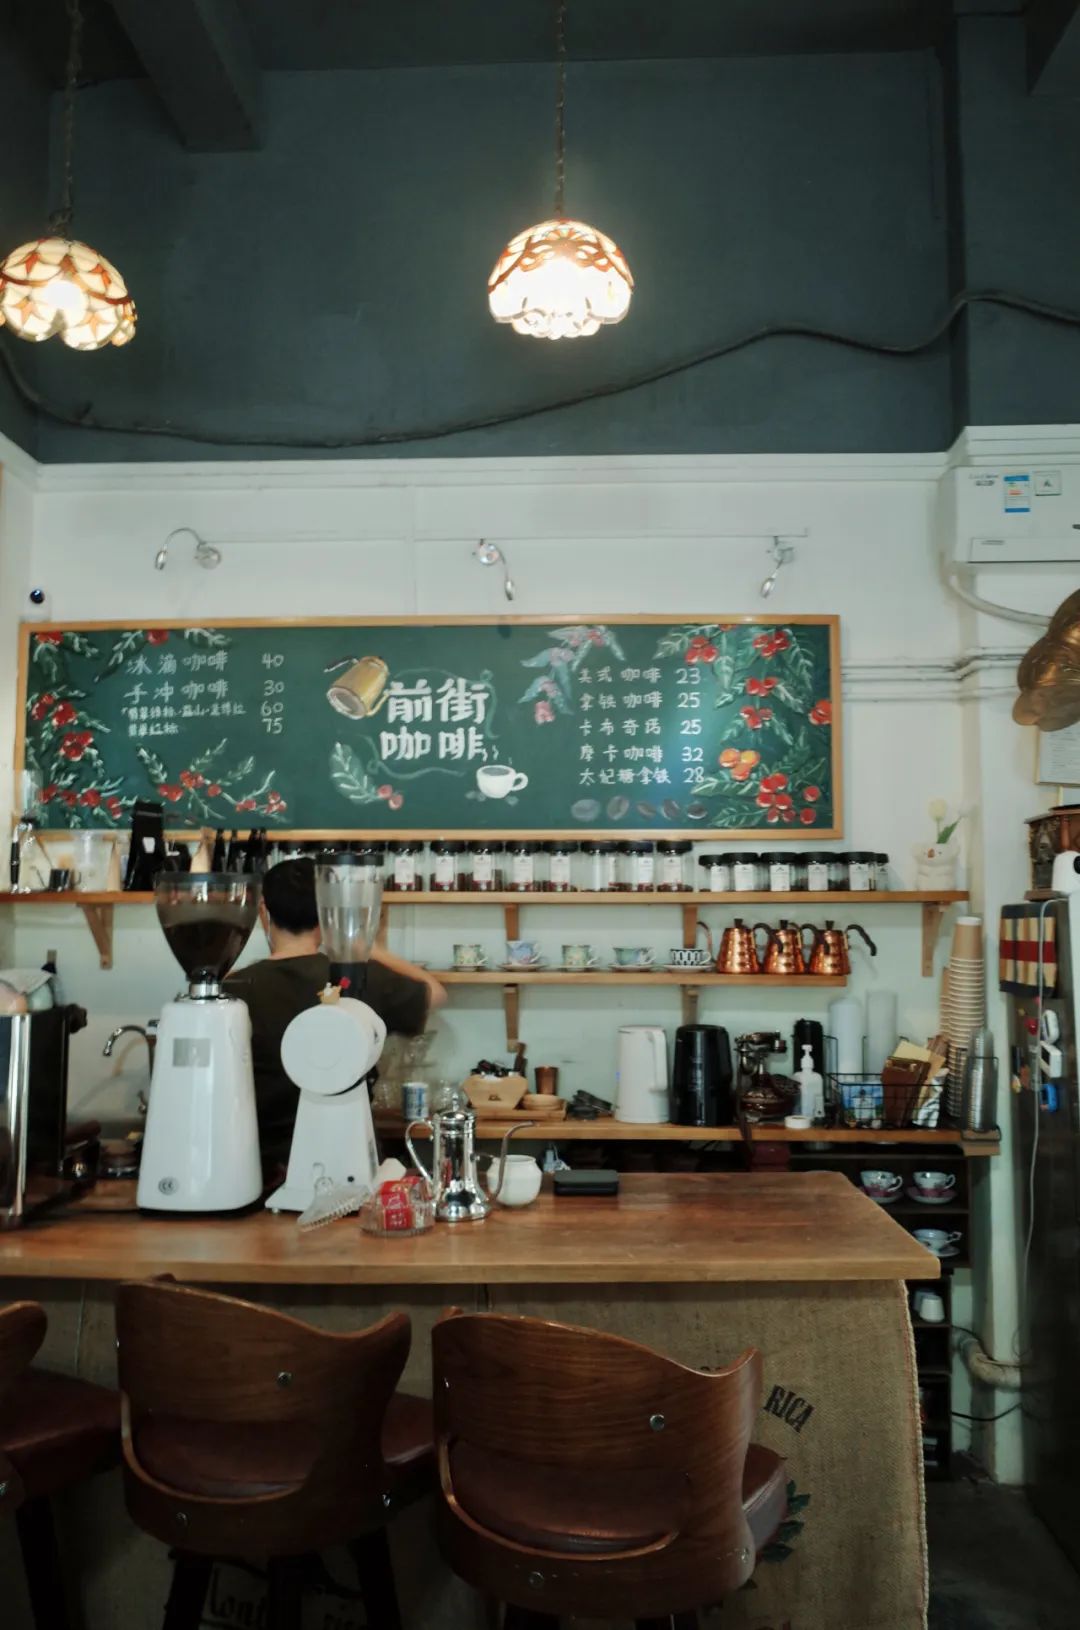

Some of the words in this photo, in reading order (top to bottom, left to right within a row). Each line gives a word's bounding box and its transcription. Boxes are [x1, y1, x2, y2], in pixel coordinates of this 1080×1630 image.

[126, 650, 228, 675] 冰滴咖啡
[262, 652, 284, 669] 40
[579, 666, 662, 684] 美式咖啡
[676, 667, 701, 684] 23
[123, 678, 229, 705] 手冲咖啡
[264, 679, 285, 696] 30
[382, 677, 490, 724] 前街
[579, 691, 663, 711] 拿铁咖啡
[677, 692, 701, 708] 25
[260, 700, 284, 717] 60
[261, 717, 284, 734] 75
[579, 718, 662, 736] 卡布奇诺
[680, 719, 702, 735] 25
[379, 726, 485, 761] 咖啡
[580, 744, 664, 763] 摩卡咖啡
[681, 746, 704, 762] 32
[579, 766, 672, 785] 太妃糖拿铁
[683, 766, 705, 783] 28
[763, 1384, 815, 1433] RICA
